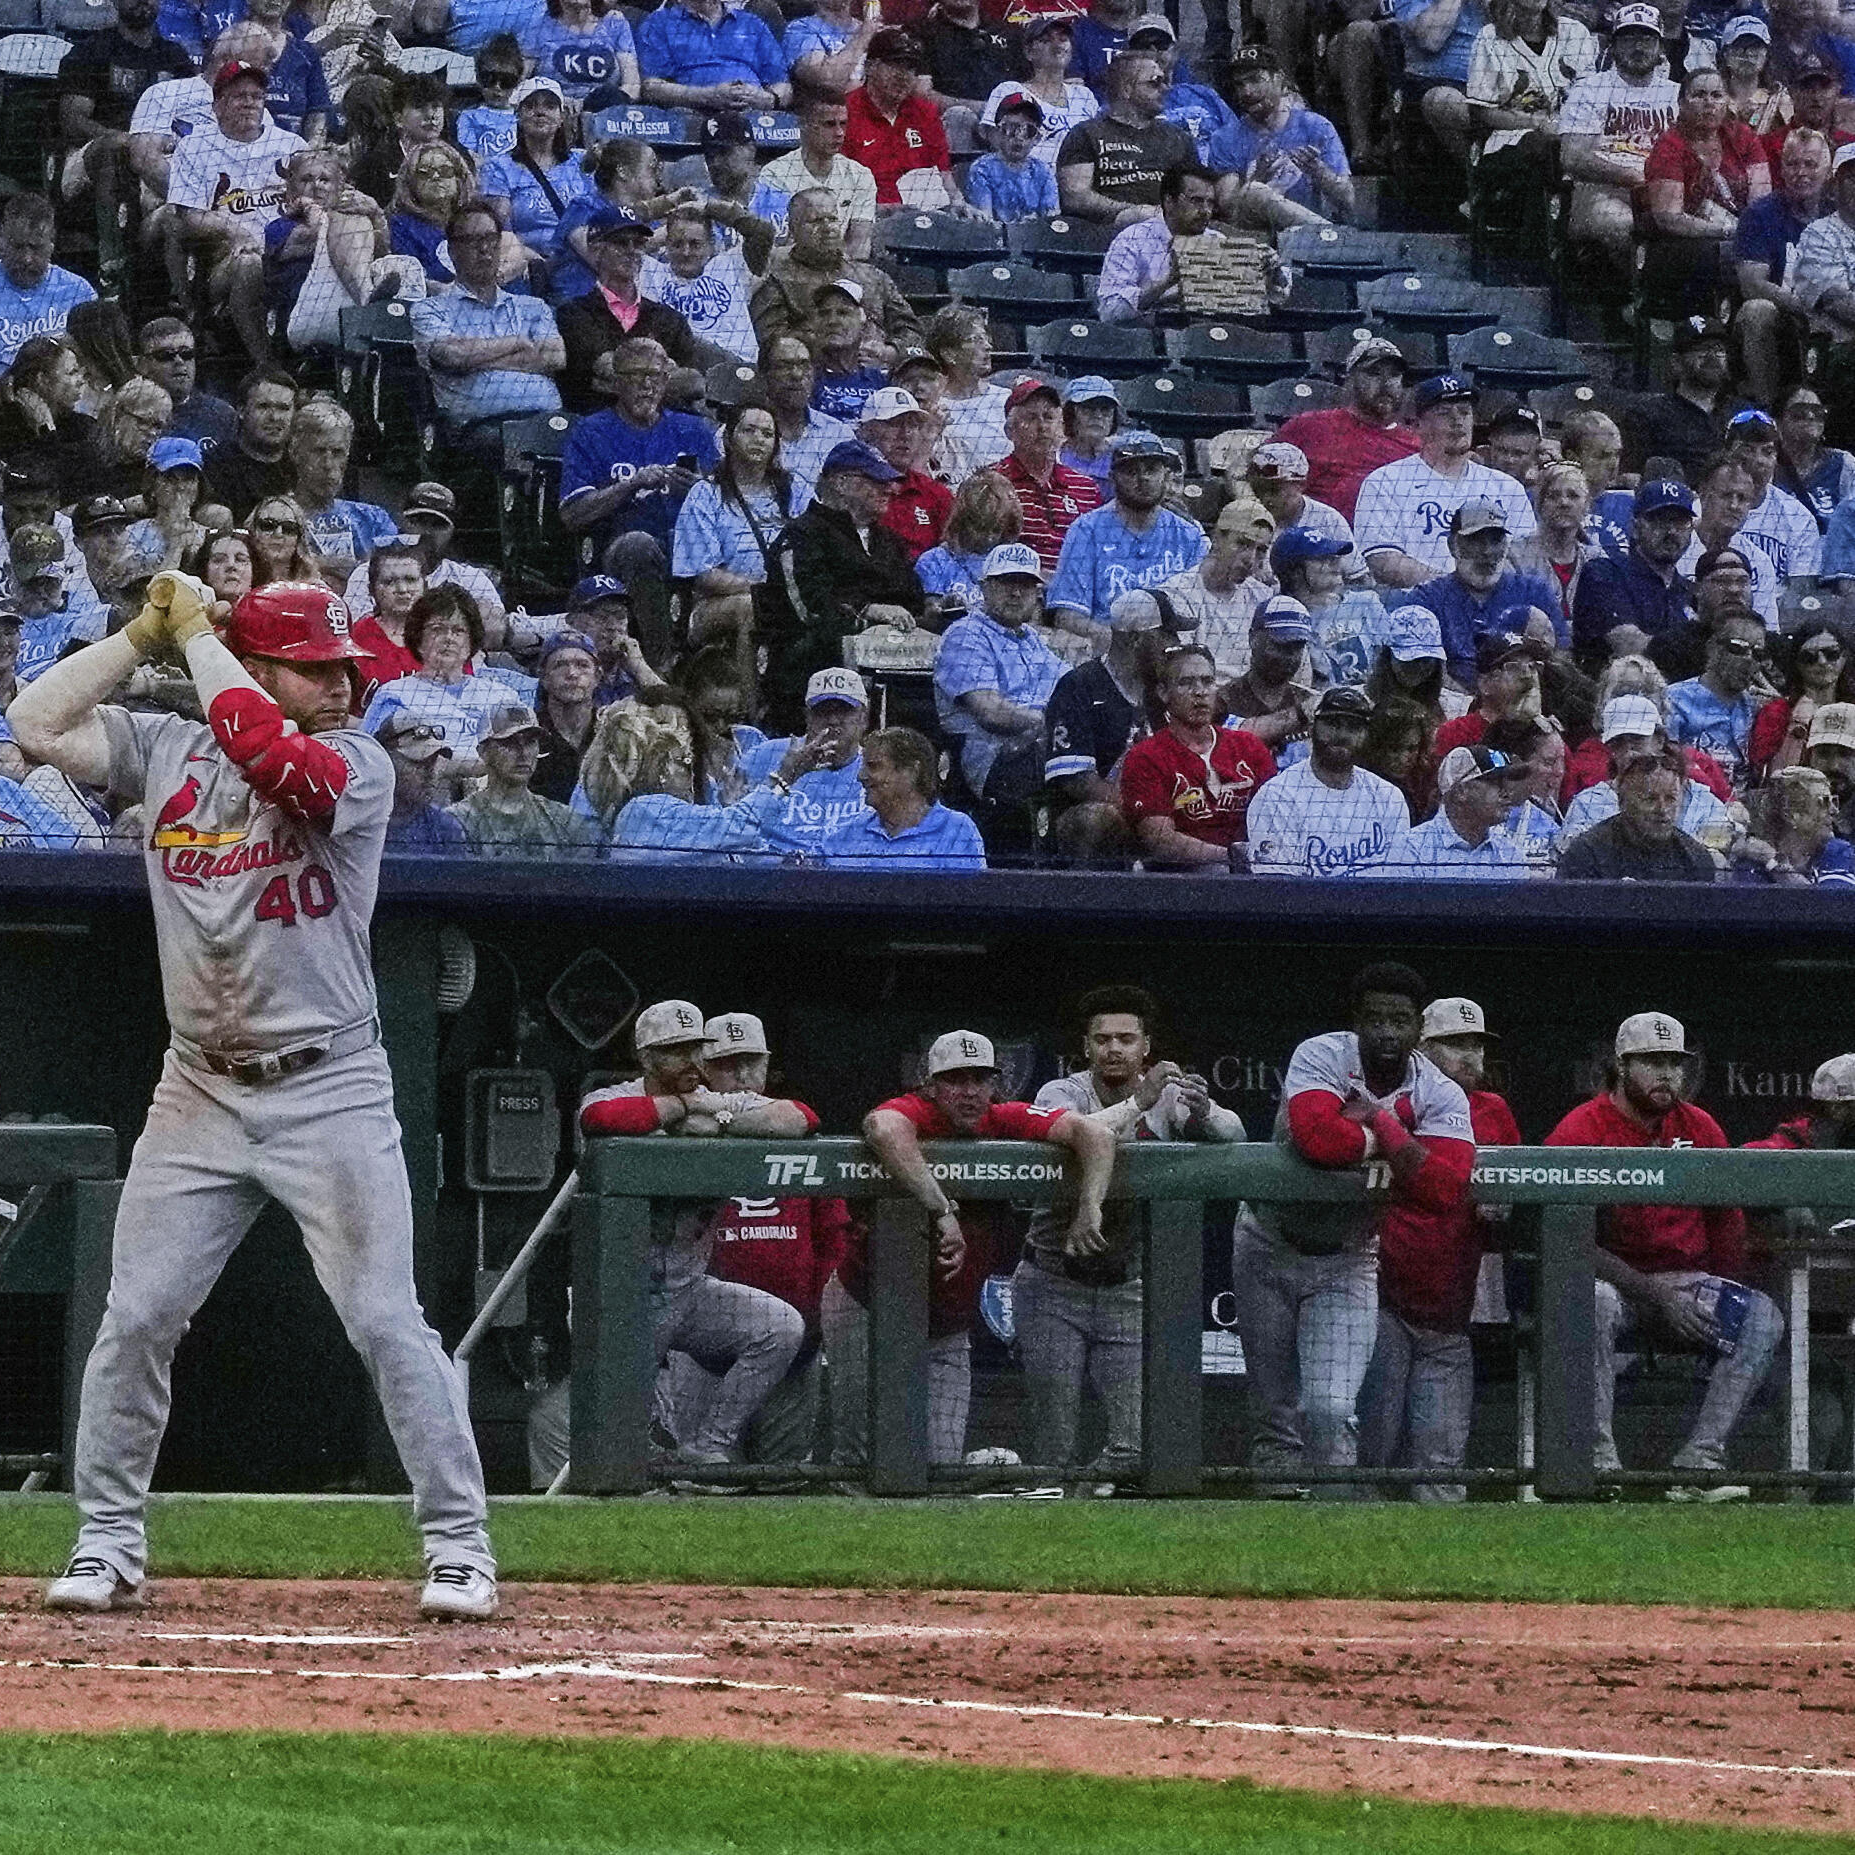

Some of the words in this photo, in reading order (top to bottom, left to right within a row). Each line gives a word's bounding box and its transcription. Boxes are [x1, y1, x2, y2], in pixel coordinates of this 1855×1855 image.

[564, 54, 605, 78] KC
[1099, 157, 1139, 170] Beer.
[162, 831, 303, 891] Cardinals
[1306, 821, 1387, 878] Royal
[254, 866, 337, 927] 40
[1725, 1061, 1807, 1098] Kan
[500, 1096, 538, 1110] PRESS
[764, 1155, 830, 1186] TFL
[1468, 1164, 1668, 1187] KETSFORLESS.COM
[740, 1223, 798, 1242] CARDINALS
